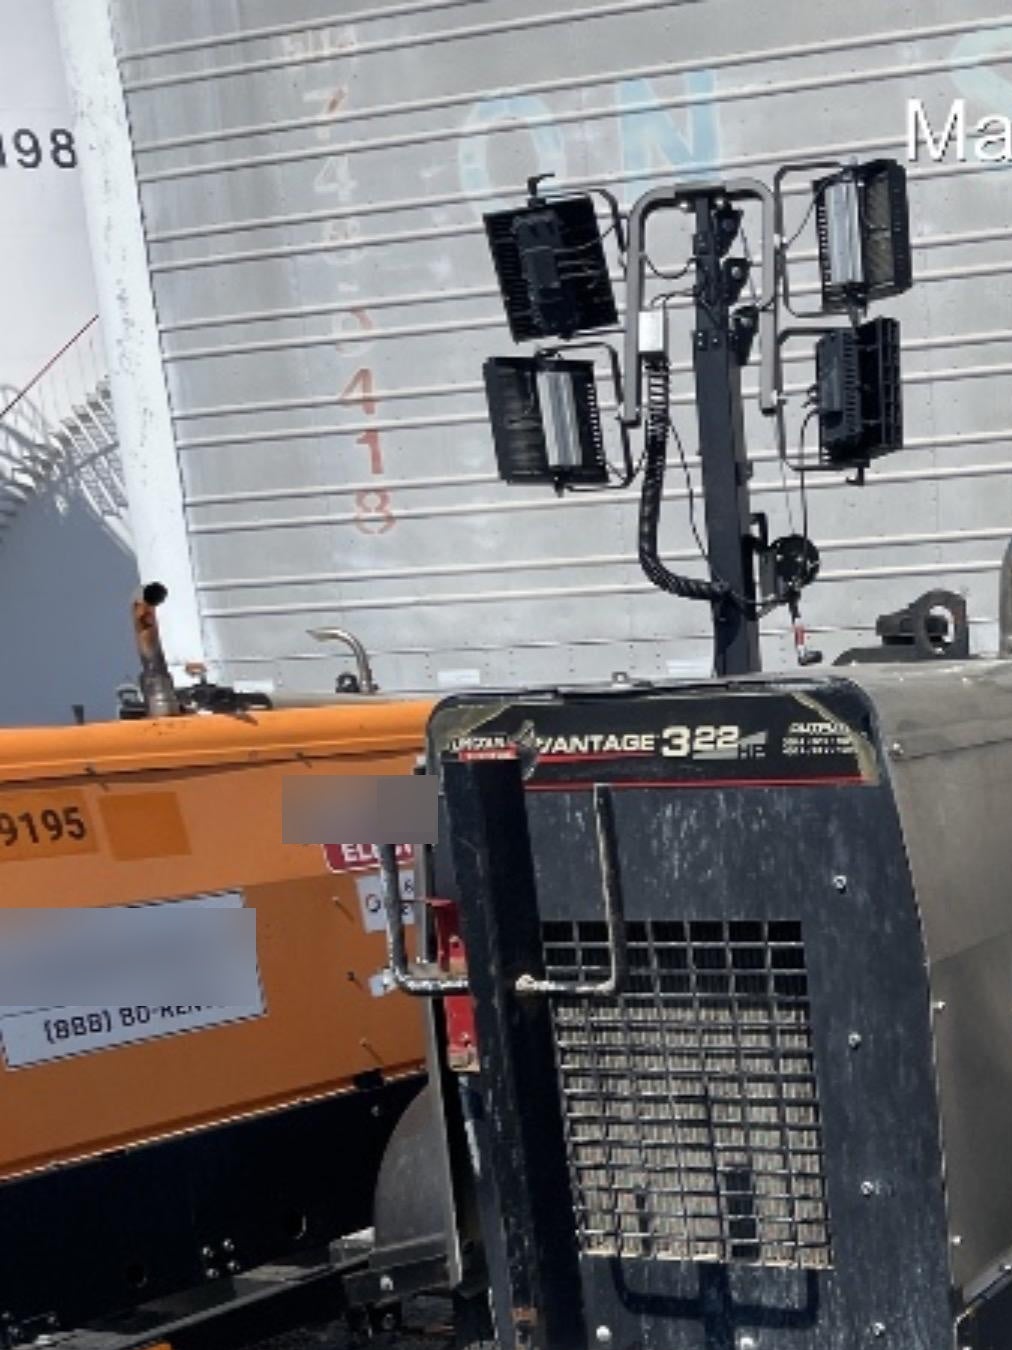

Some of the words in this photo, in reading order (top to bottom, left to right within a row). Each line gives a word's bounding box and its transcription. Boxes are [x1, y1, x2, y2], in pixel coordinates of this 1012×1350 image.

[0, 128, 78, 168] 98
[661, 724, 740, 758] 322
[44, 1009, 113, 1045] (888)
